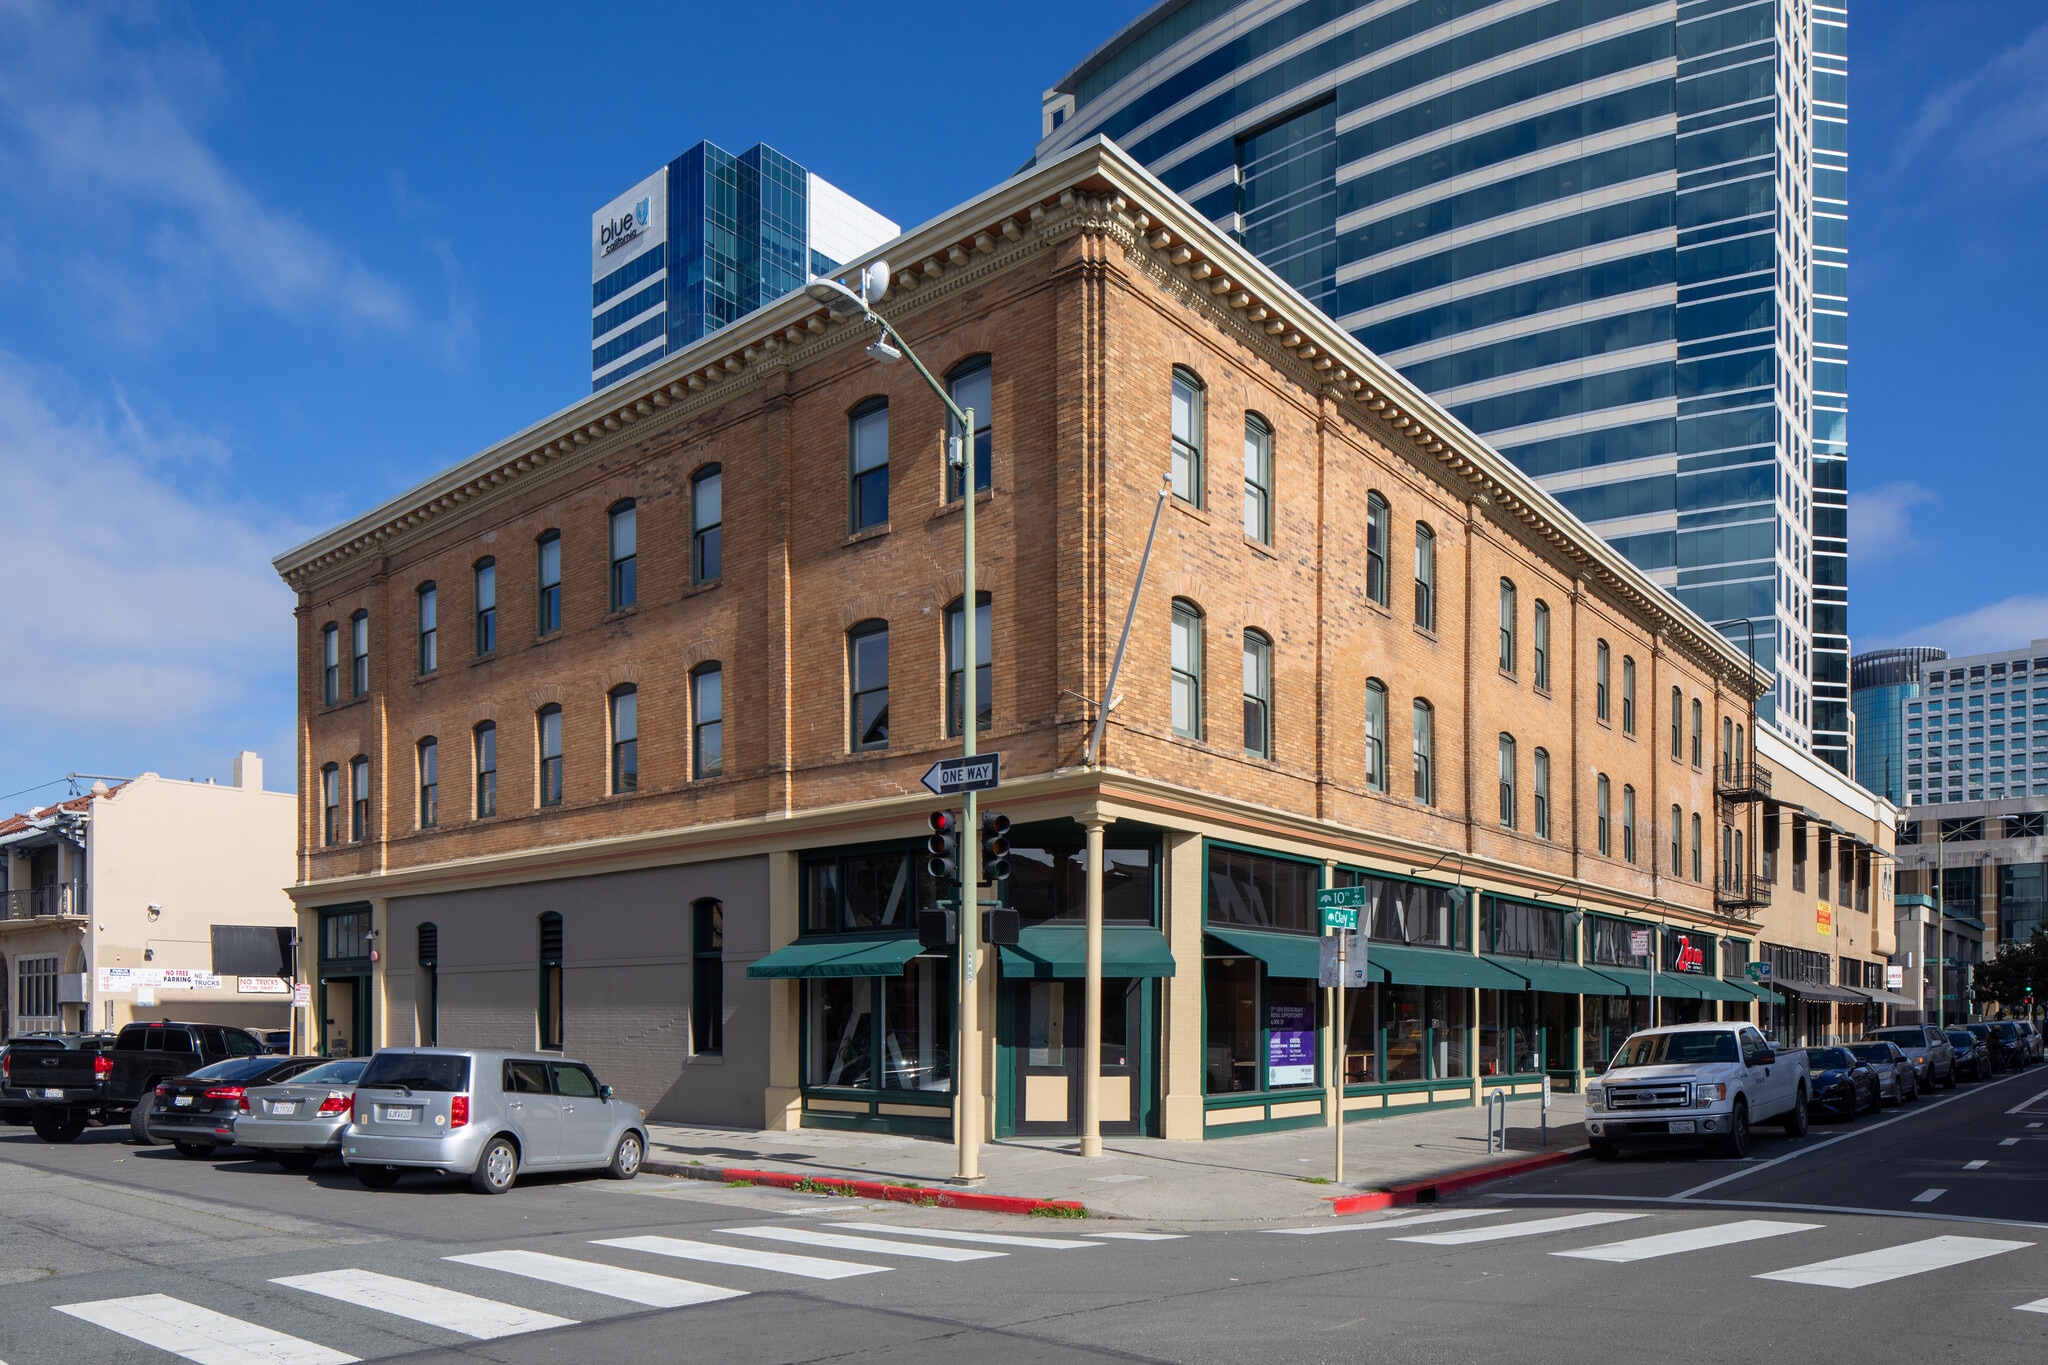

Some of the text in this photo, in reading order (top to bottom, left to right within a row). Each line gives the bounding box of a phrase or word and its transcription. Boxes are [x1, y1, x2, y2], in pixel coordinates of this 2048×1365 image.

[601, 213, 633, 246] blue
[605, 229, 637, 253] california
[942, 765, 989, 783] ONE WAY
[1334, 910, 1348, 927] Clay
[256, 978, 279, 986] TRUCKS
